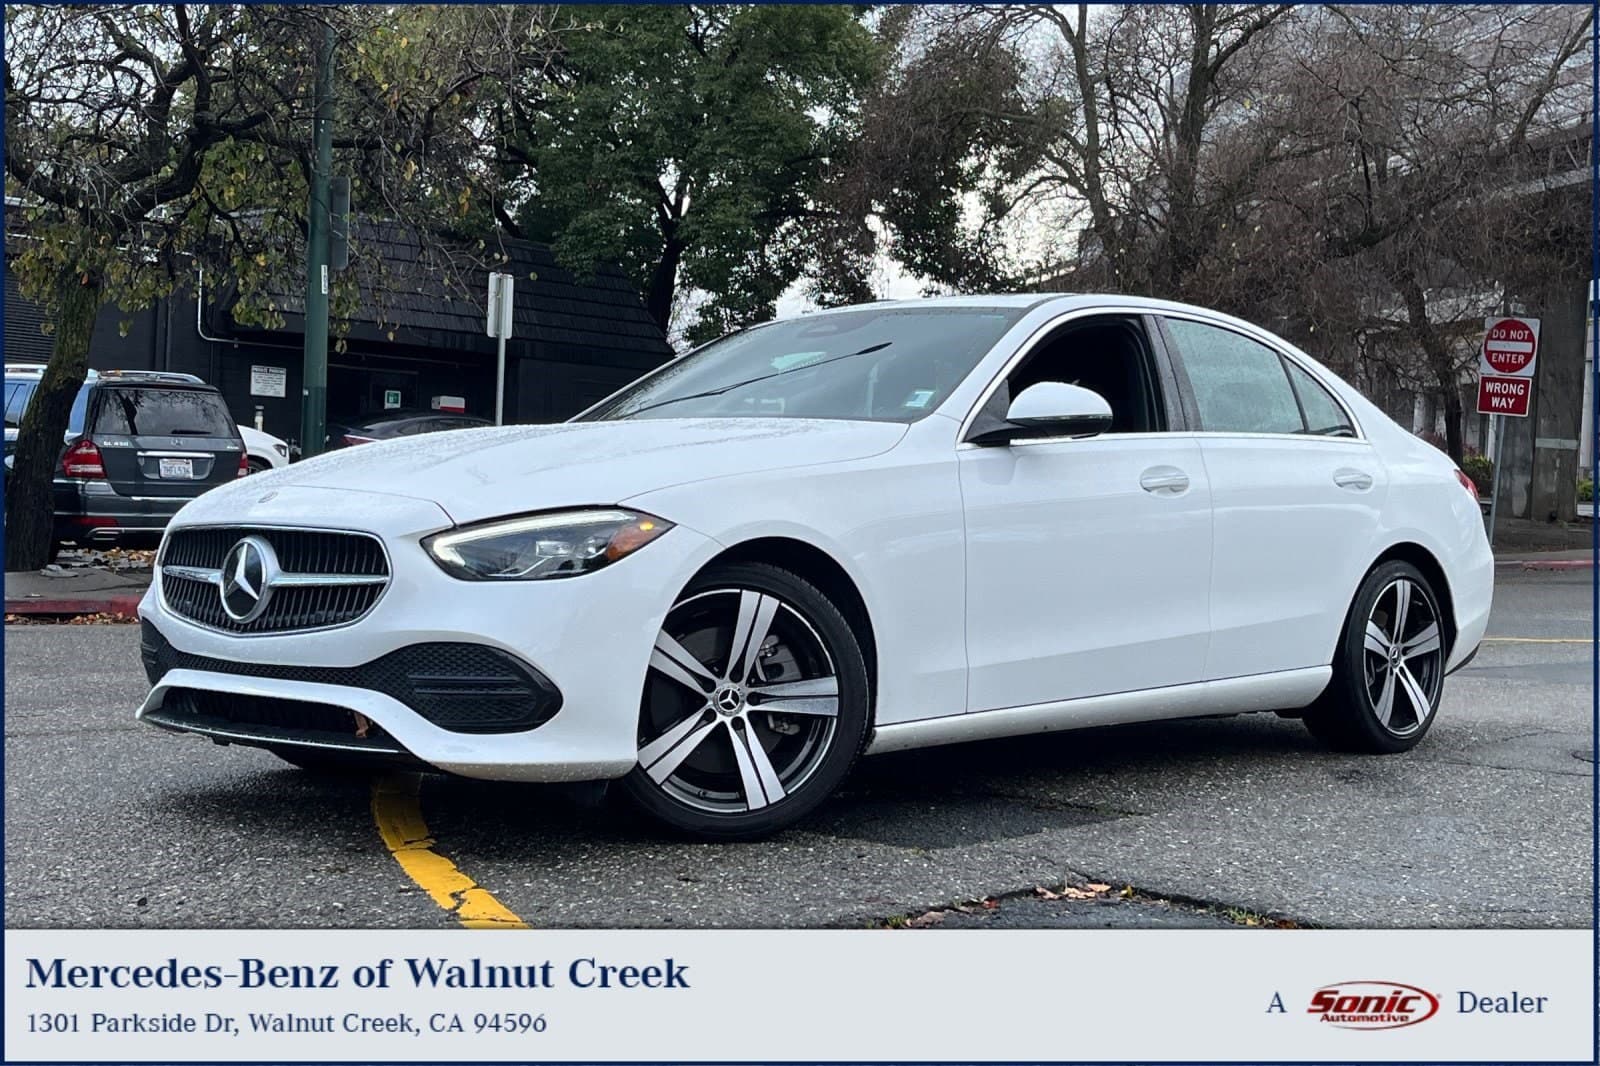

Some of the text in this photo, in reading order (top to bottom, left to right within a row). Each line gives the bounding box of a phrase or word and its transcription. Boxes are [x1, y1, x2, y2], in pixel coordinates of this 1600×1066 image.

[1492, 329, 1530, 340] DO NOT
[1491, 353, 1525, 364] ENTER
[1485, 382, 1525, 395] WRONG
[1491, 397, 1515, 408] WAY
